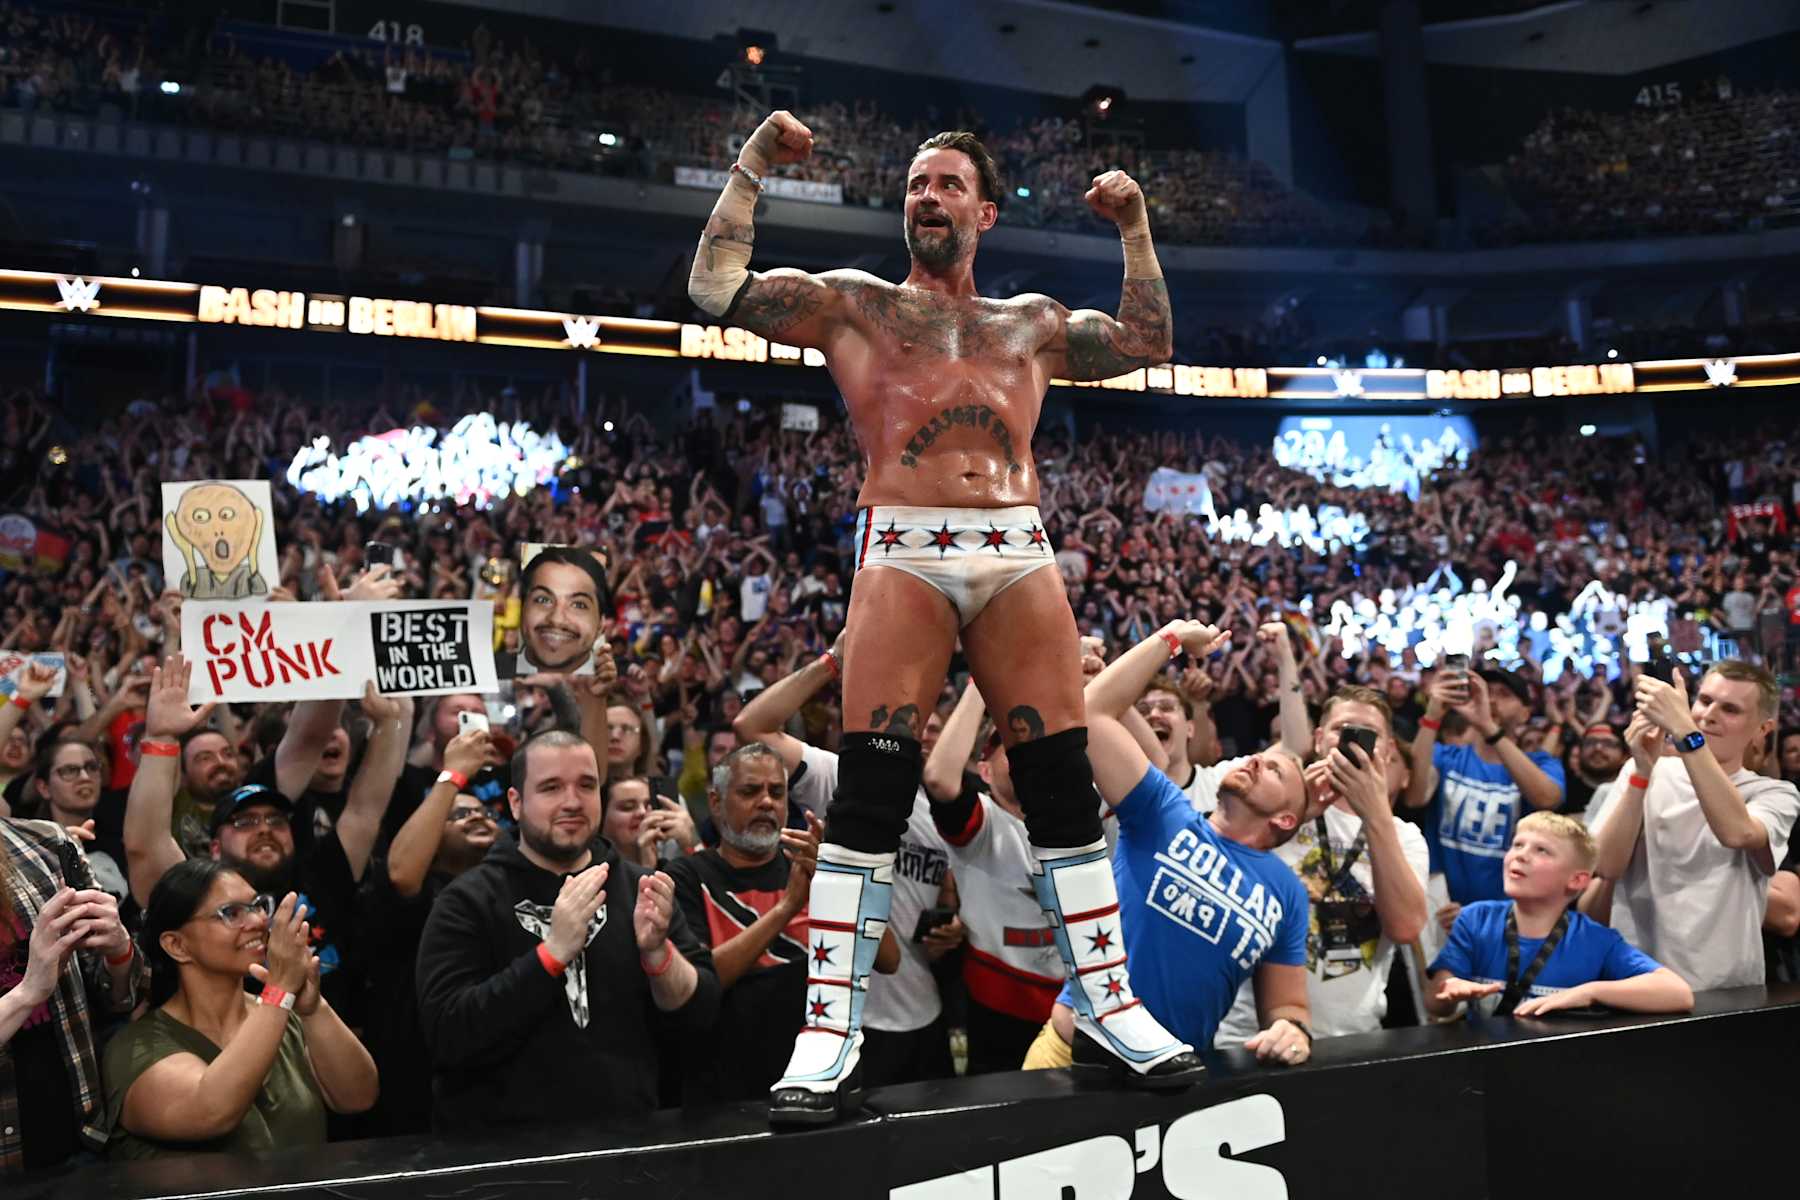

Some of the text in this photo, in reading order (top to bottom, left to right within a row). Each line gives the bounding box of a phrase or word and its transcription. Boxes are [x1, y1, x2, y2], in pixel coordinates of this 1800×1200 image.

[199, 285, 305, 329] BASH
[349, 296, 477, 343] BERLIN
[680, 324, 768, 362] BASH
[1174, 364, 1267, 398] BERLIN
[1426, 369, 1500, 399] BASH
[1532, 363, 1635, 397] BERLIN
[203, 610, 275, 656] CM
[380, 612, 468, 644] BEST
[206, 638, 341, 696] PUNK
[388, 641, 458, 665] IN THE
[378, 664, 474, 691] WORLD
[1168, 829, 1283, 938] COLLAR
